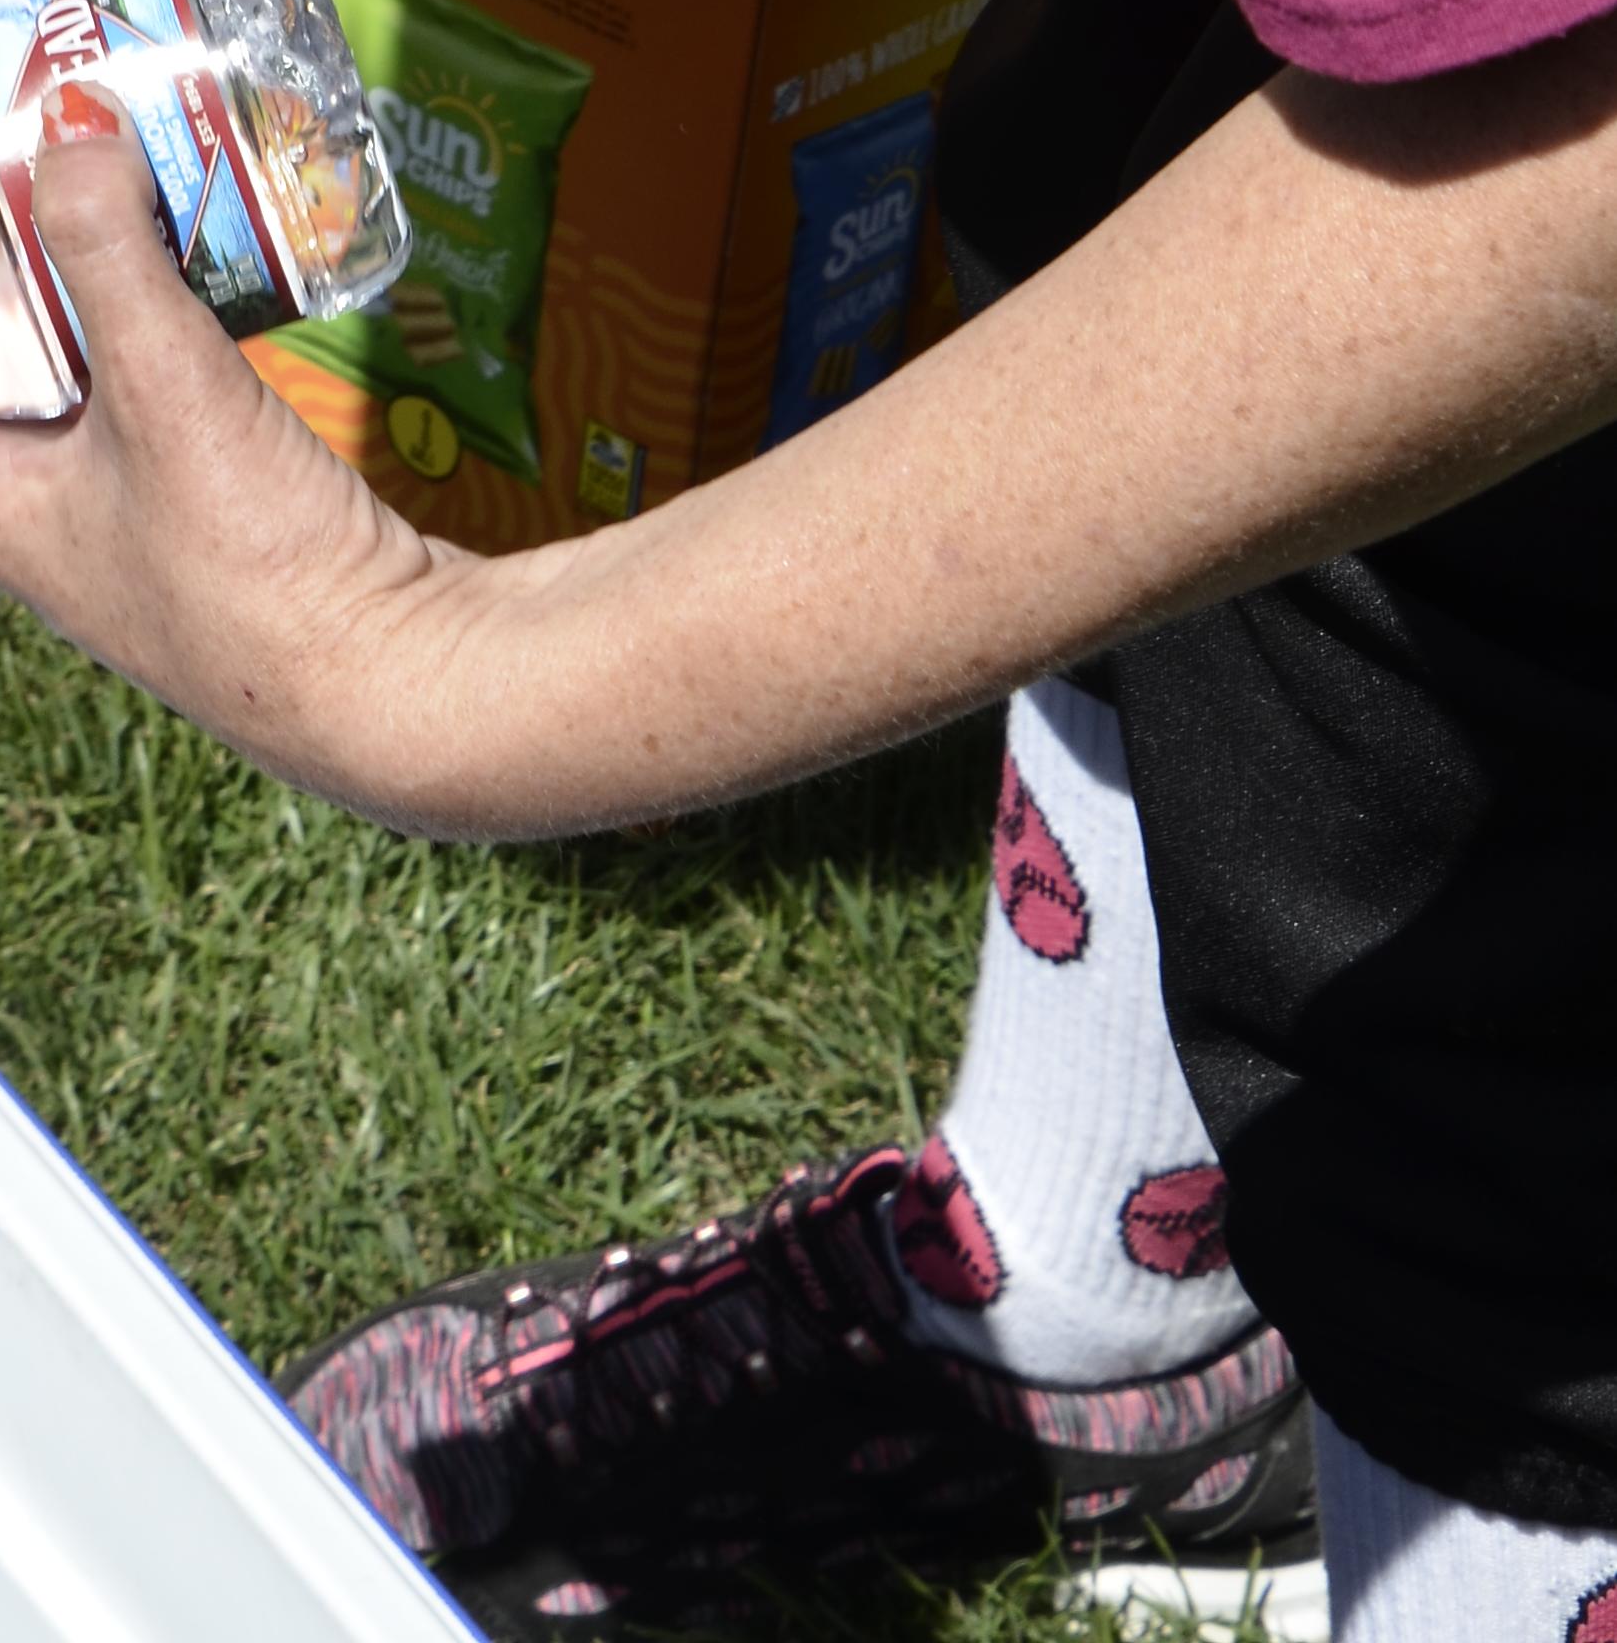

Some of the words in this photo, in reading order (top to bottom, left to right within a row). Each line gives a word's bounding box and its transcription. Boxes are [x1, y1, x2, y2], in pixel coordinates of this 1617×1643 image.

[368, 85, 501, 190] Sun
[161, 162, 191, 216] 100%
[822, 190, 915, 281] Sun
